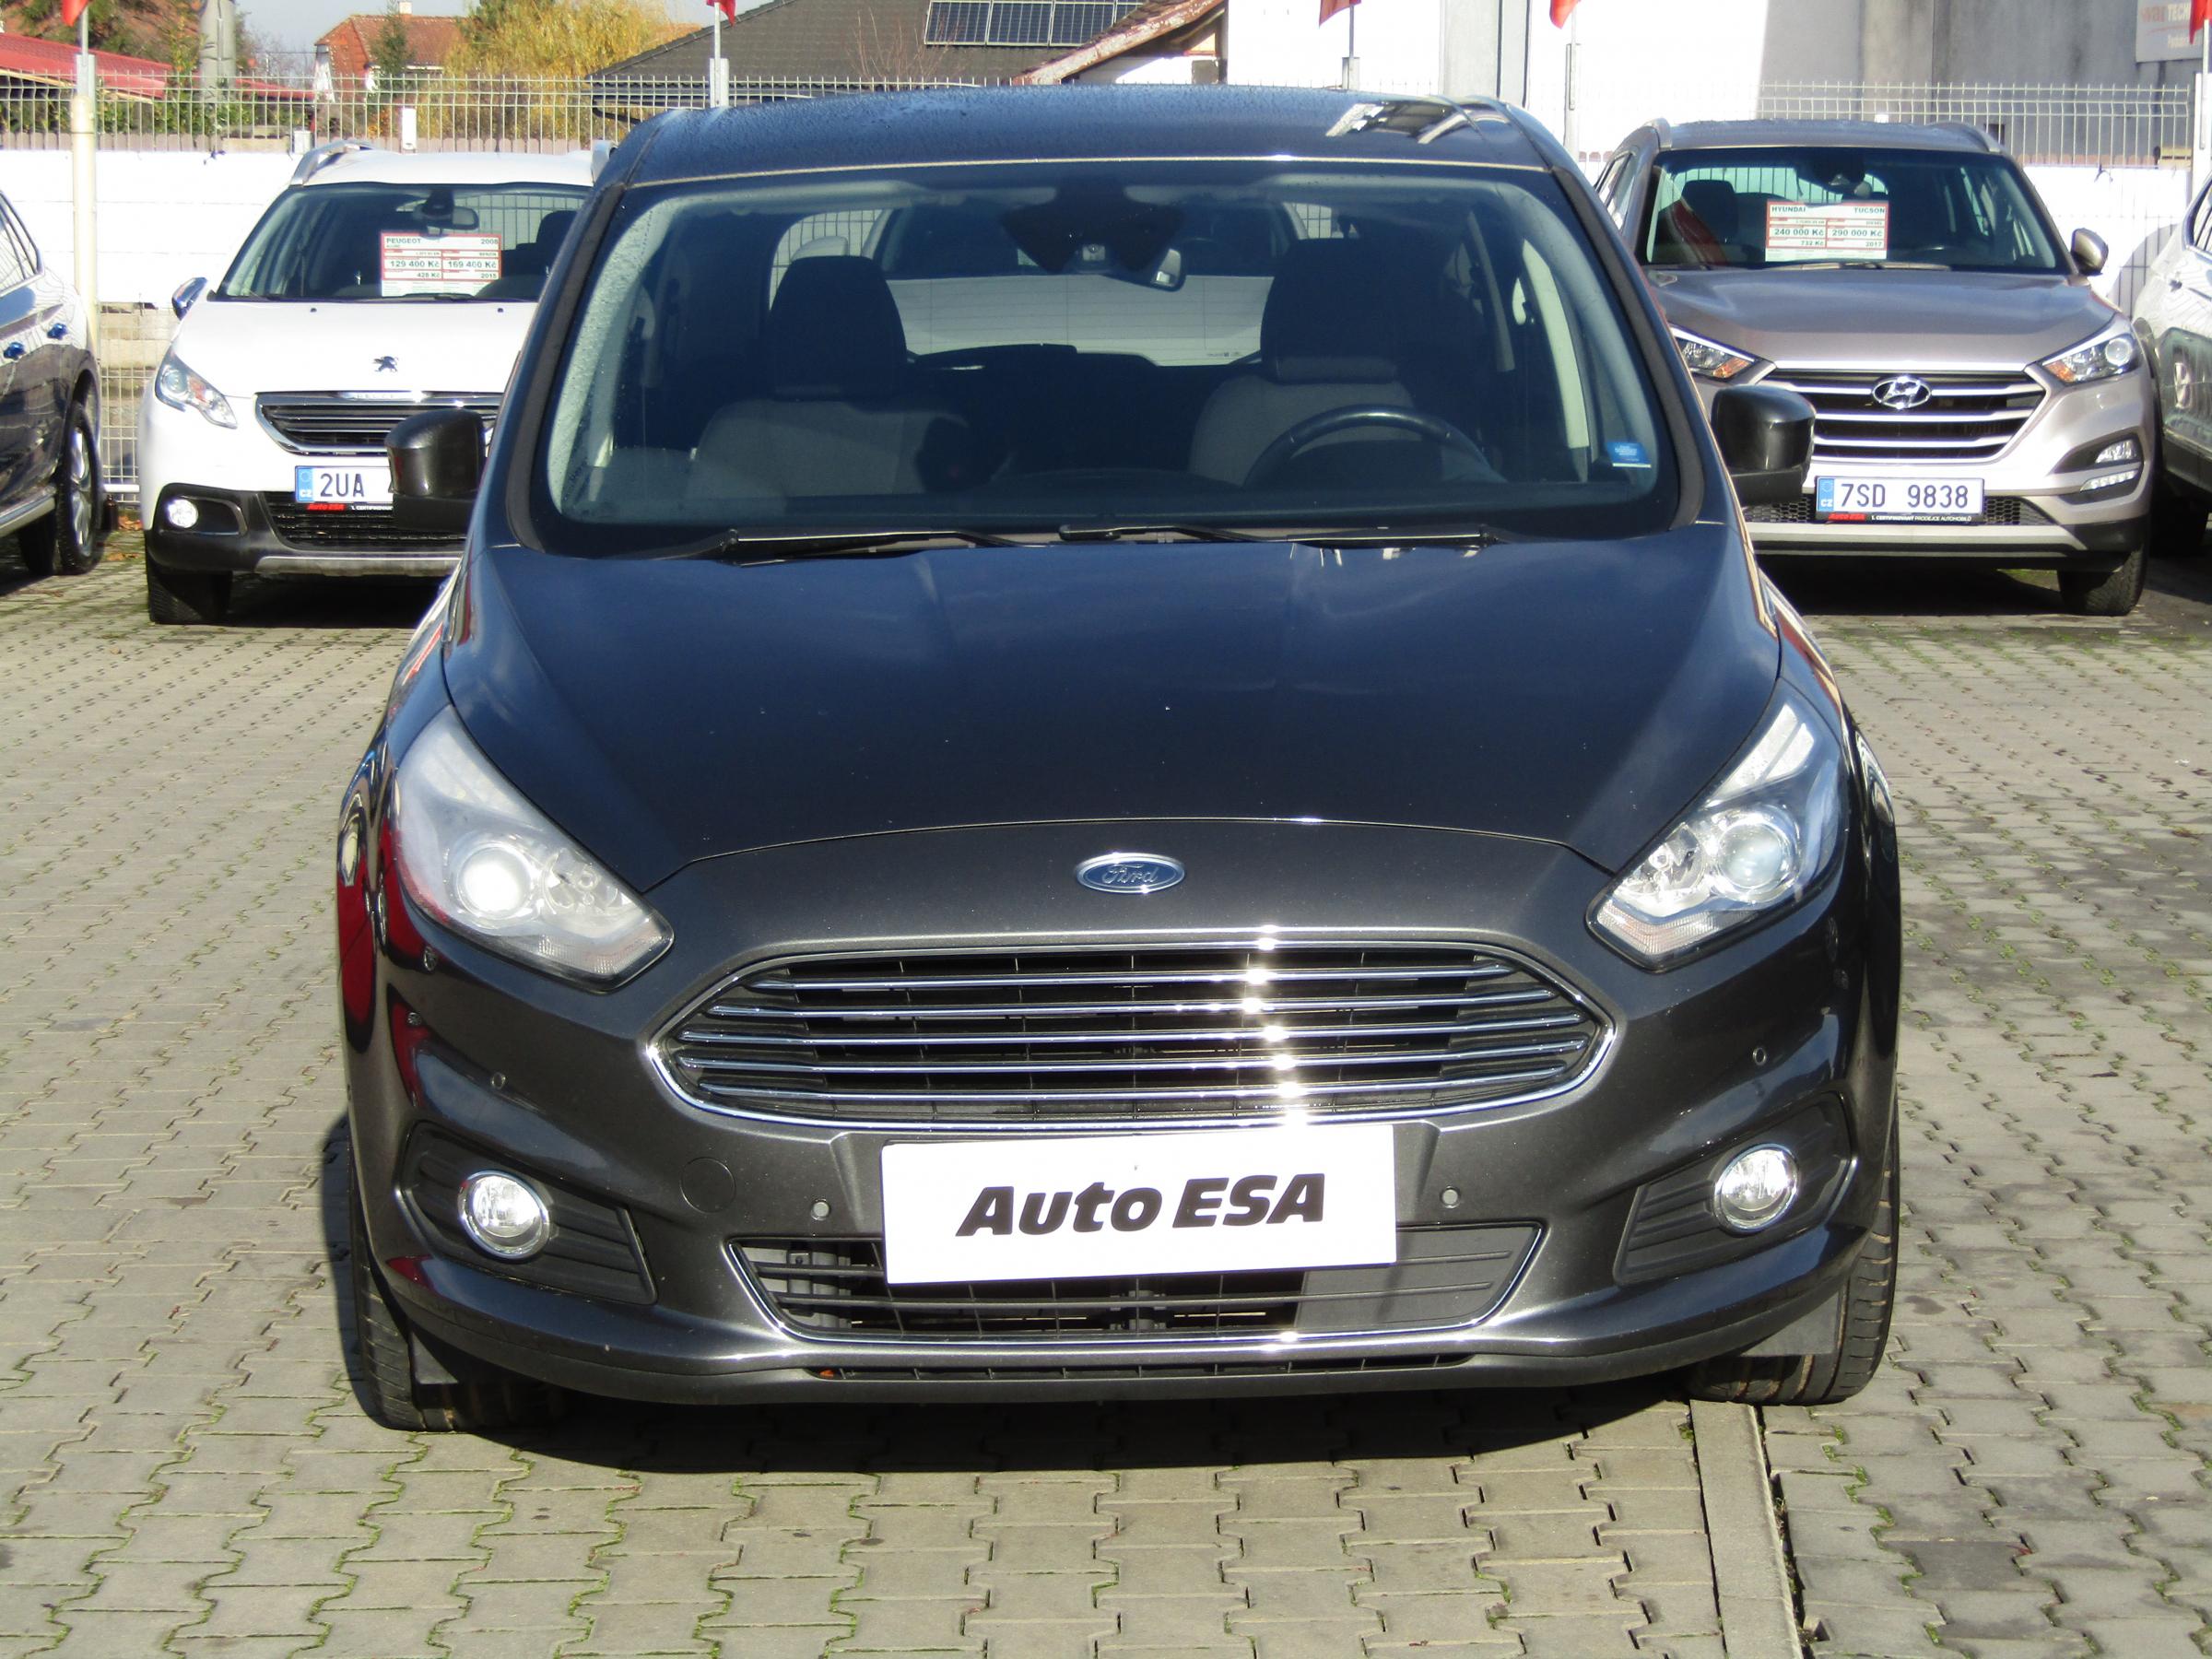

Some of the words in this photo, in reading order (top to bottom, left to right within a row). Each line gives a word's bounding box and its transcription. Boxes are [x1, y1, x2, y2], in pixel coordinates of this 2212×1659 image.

[300, 489, 312, 498] CZ
[320, 473, 365, 498] 2UA
[1841, 484, 1886, 507] 7SD
[1908, 485, 1969, 508] 9838
[1820, 499, 1832, 507] CZ
[1101, 863, 1159, 884] Ford
[955, 1182, 1163, 1237] Auto
[1172, 1173, 1326, 1229] ESA
